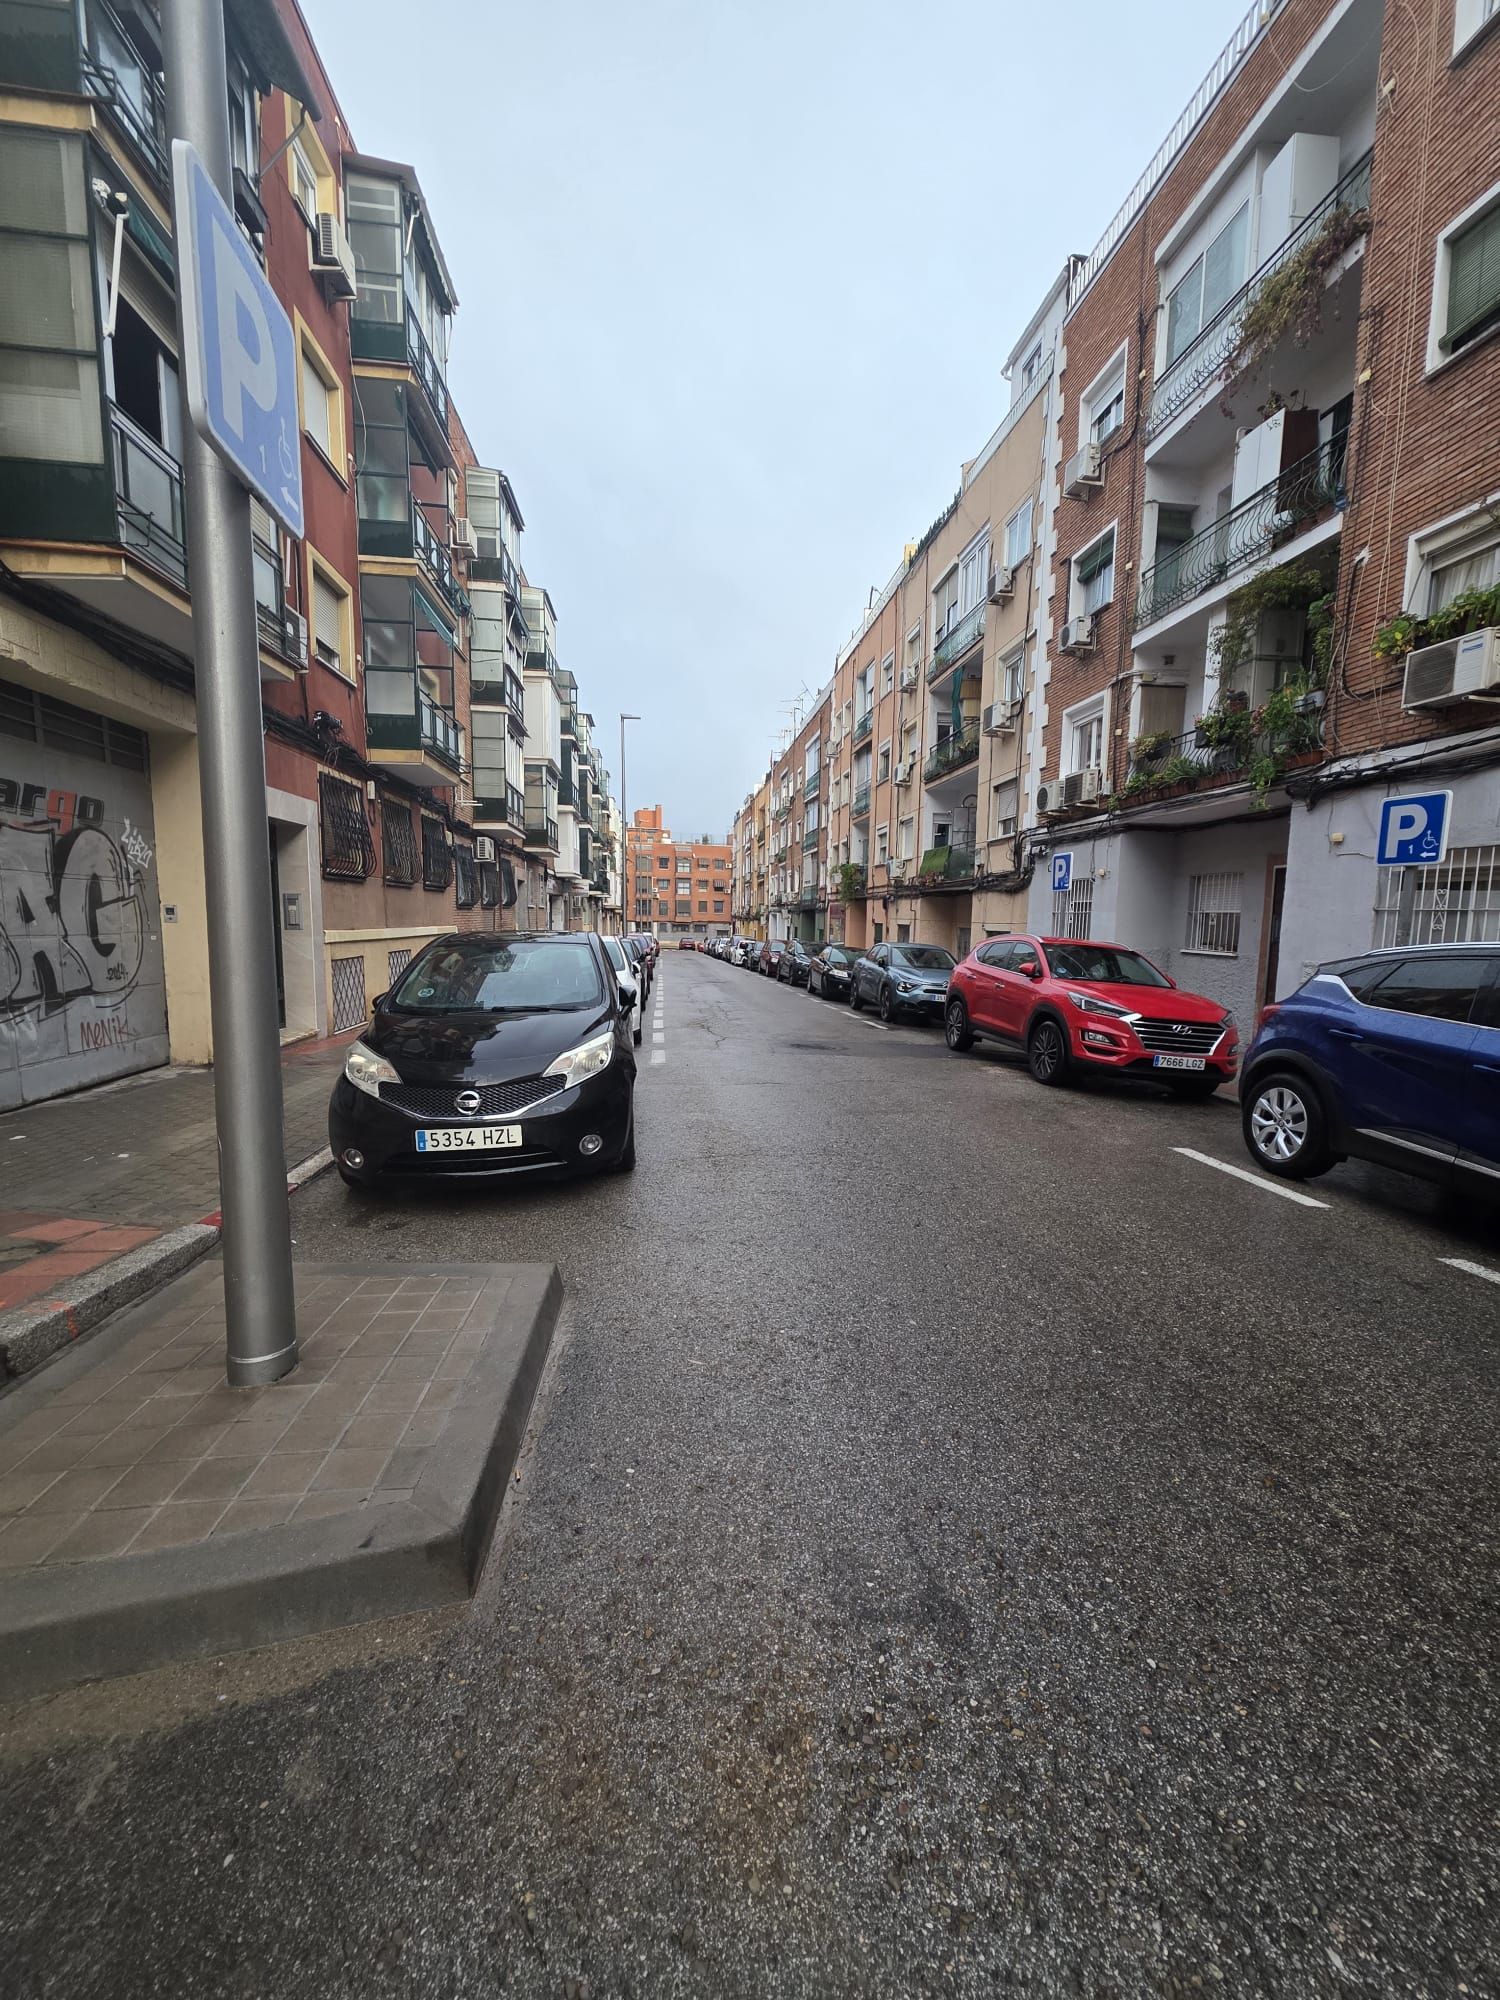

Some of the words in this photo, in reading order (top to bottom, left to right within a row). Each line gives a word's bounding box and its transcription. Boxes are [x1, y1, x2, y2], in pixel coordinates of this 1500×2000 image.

[211, 212, 278, 443] P
[258, 445, 267, 474] 1
[1384, 803, 1428, 859] P
[1408, 844, 1414, 855] 1
[1054, 858, 1067, 888] P
[1160, 1056, 1184, 1067] 7666
[1185, 1058, 1205, 1069] LGZ
[429, 1130, 476, 1148] 5354
[482, 1128, 517, 1146] HZL
